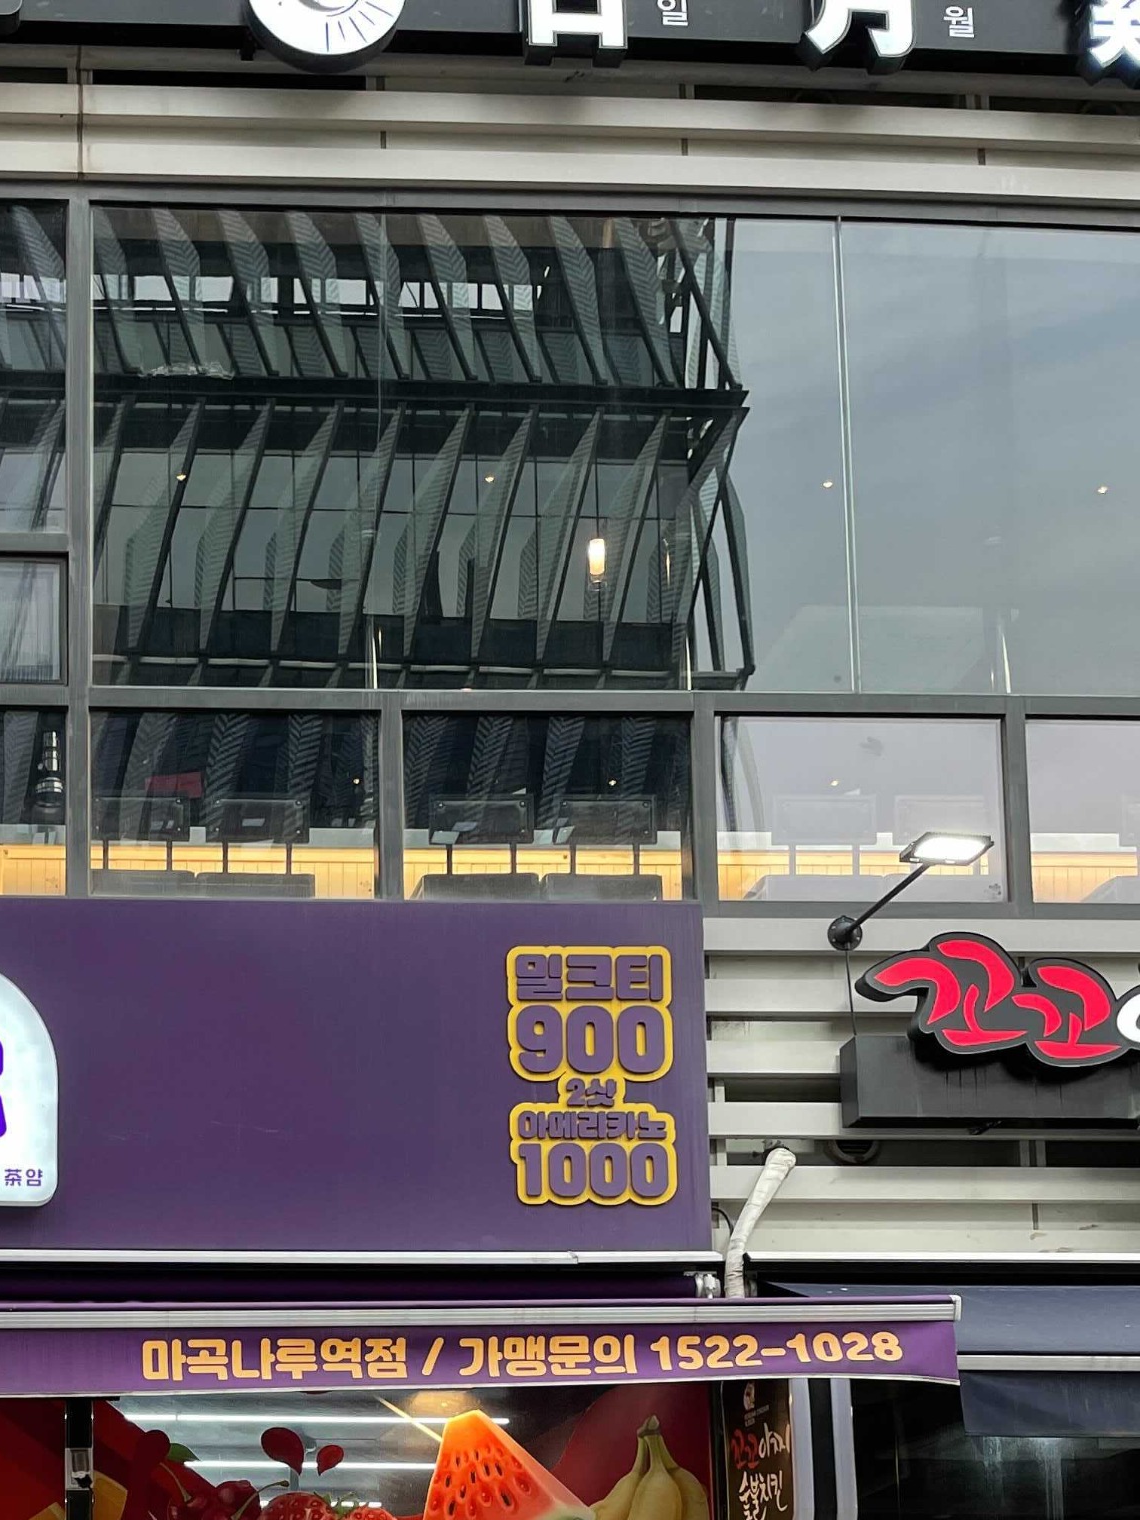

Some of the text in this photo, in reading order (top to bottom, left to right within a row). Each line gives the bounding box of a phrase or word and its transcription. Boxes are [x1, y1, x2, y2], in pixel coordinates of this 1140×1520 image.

[515, 953, 664, 1002] 밀크티
[873, 939, 1140, 1060] 꼬꼬
[516, 1004, 665, 1075] 900
[517, 1110, 668, 1140] 아메리카노
[518, 1142, 669, 1199] 1000
[142, 1330, 904, 1382] 마곡나루역점 / 가맹문의 1522-1028
